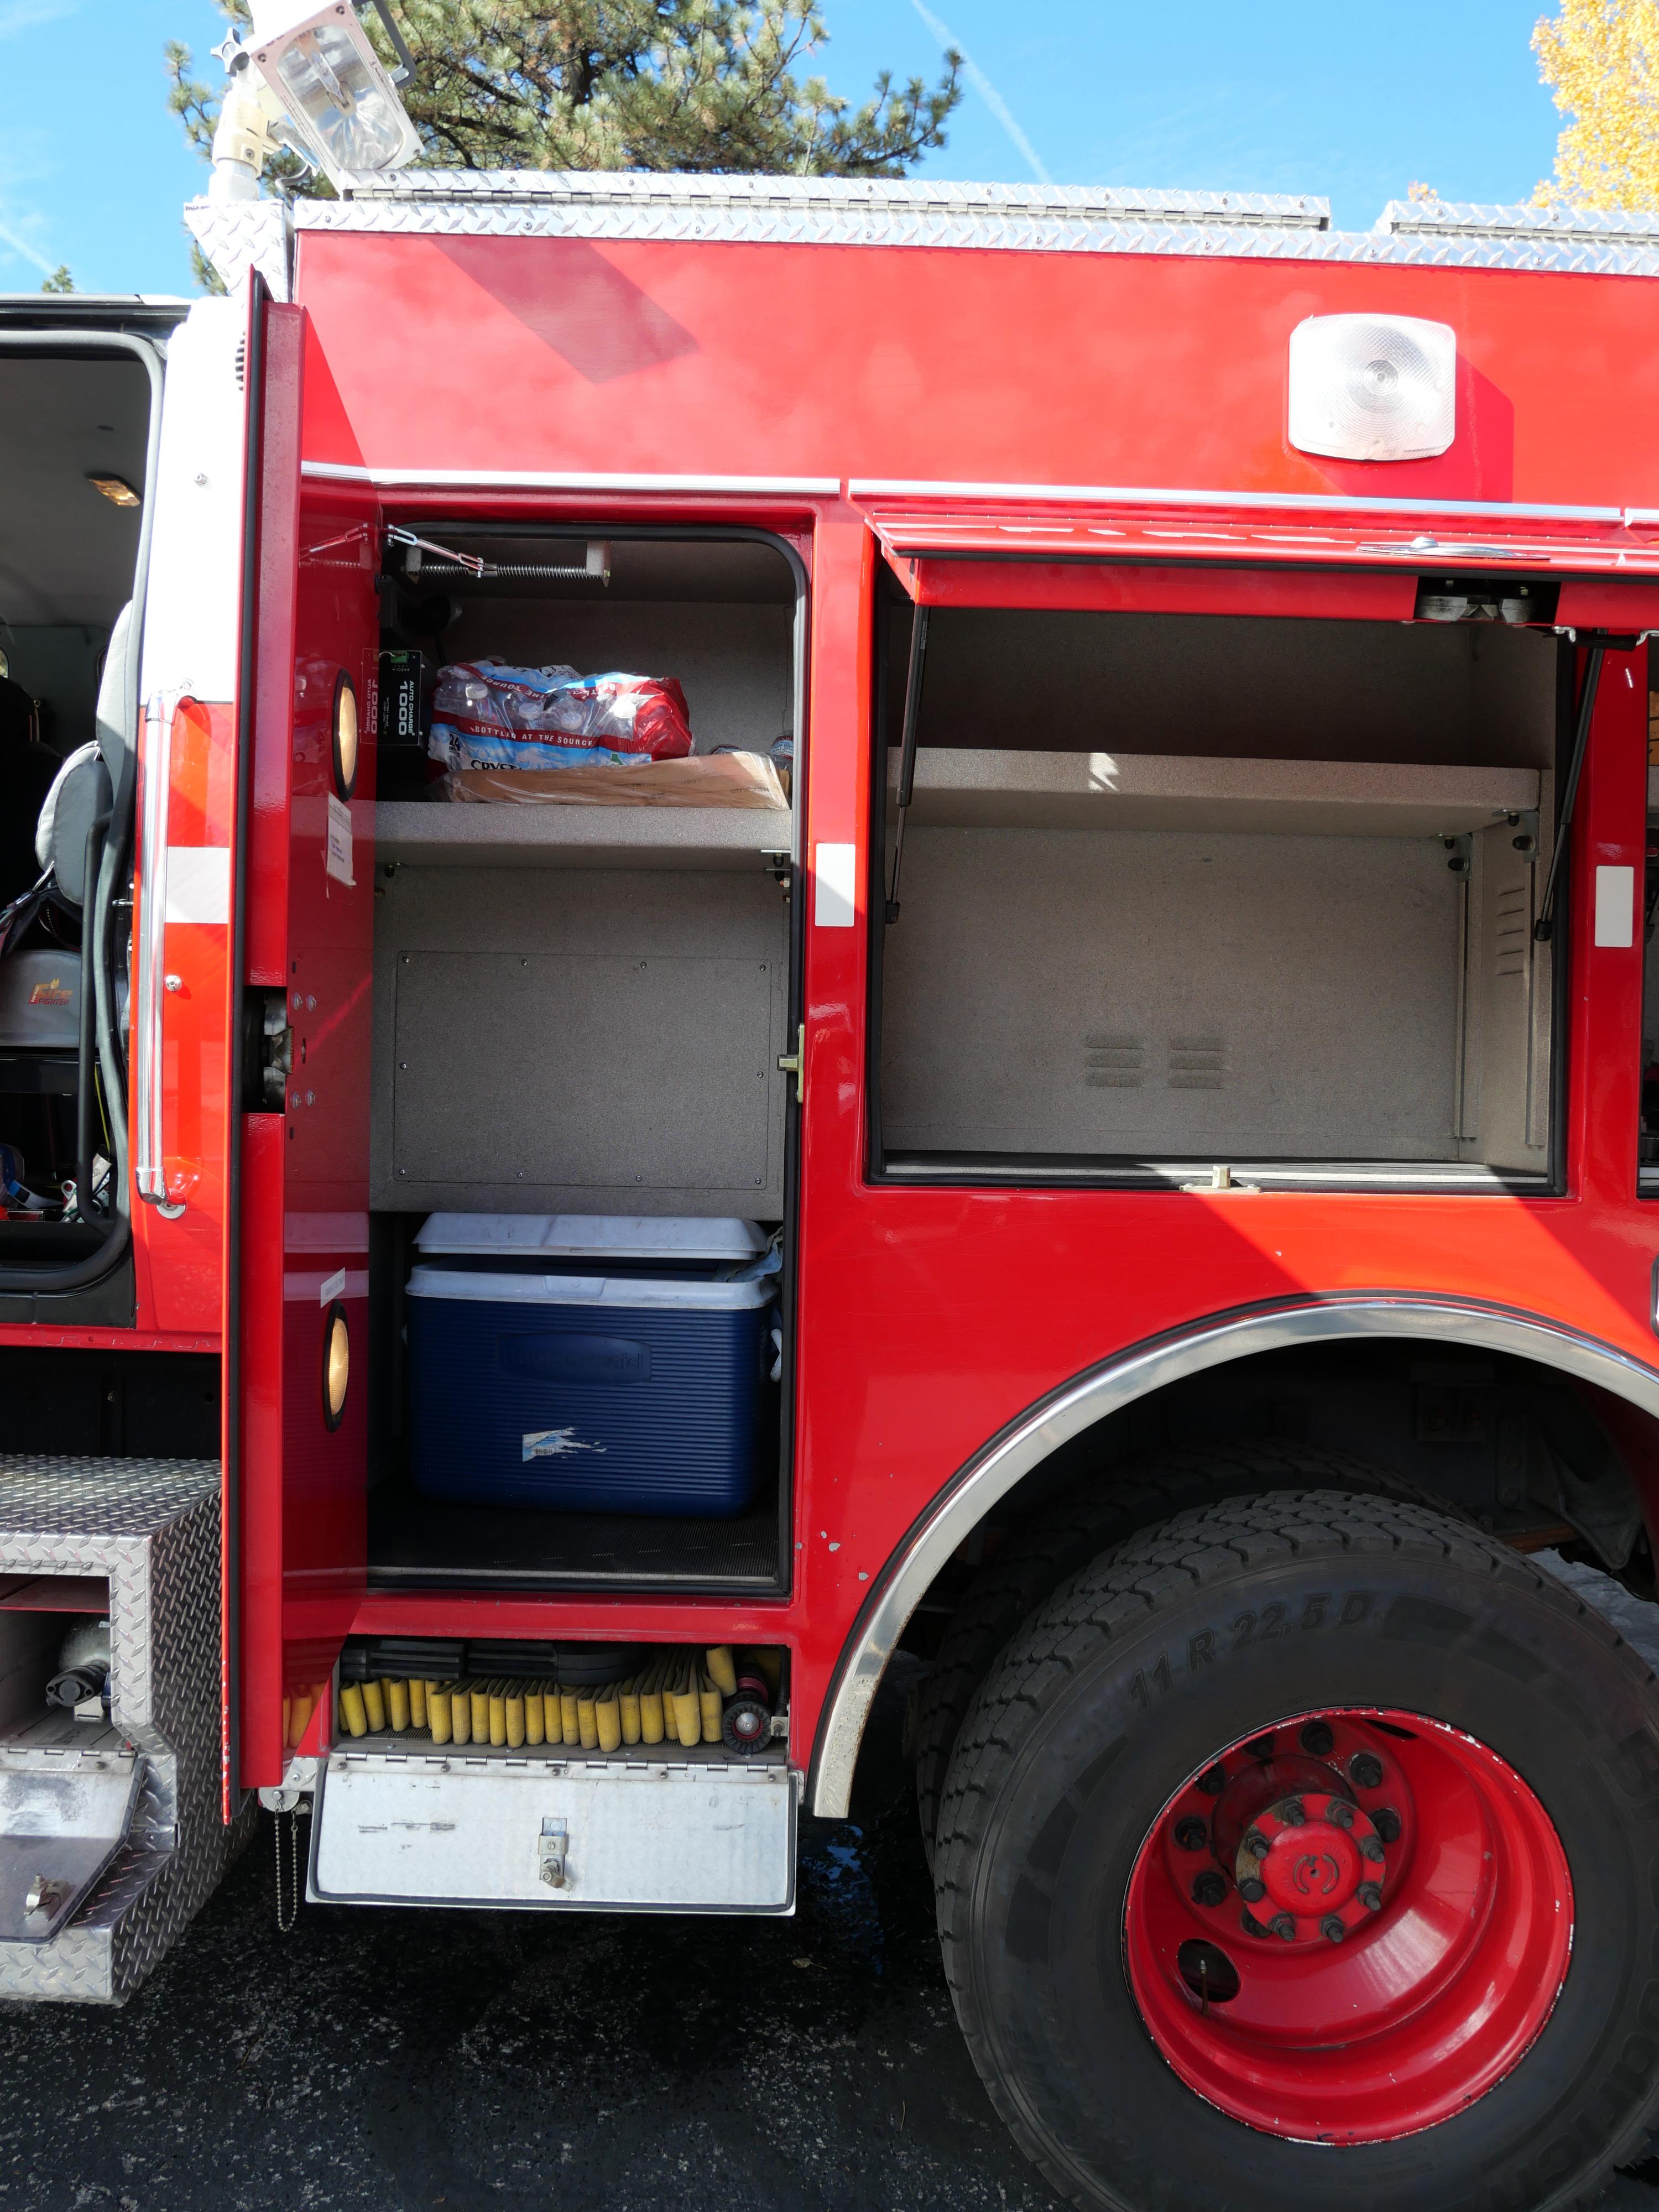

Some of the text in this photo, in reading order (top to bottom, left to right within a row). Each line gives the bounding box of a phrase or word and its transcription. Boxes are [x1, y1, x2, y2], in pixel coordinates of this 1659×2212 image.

[399, 681, 408, 735] 1000
[474, 726, 517, 739] BOTTLED
[539, 734, 555, 742] THE
[557, 736, 593, 747] SOURCE
[1130, 1592, 1373, 1709] 11 R 22.5 D
